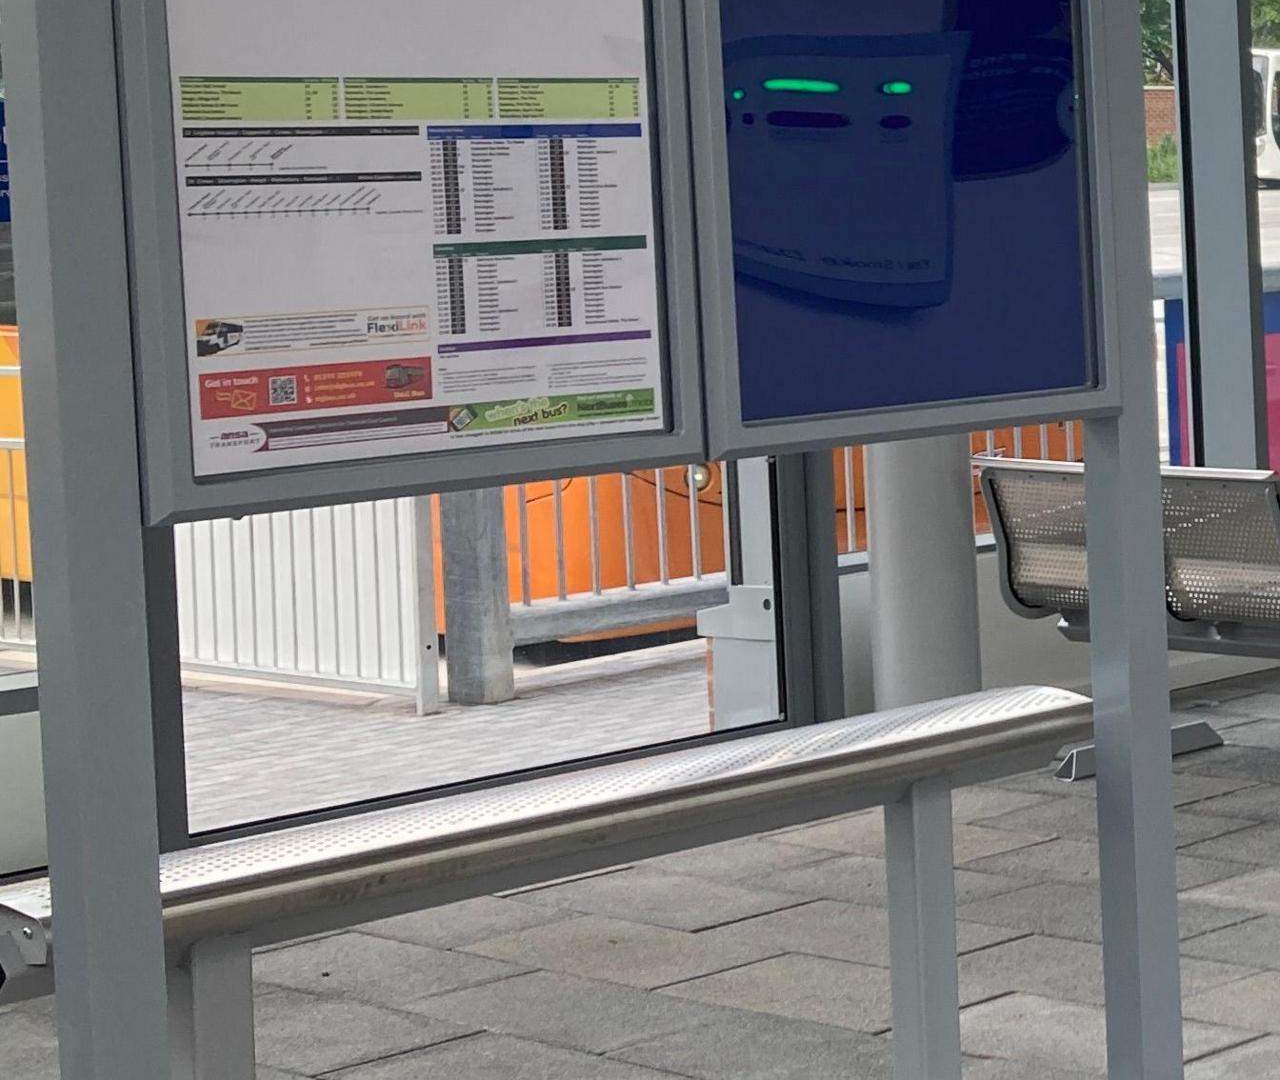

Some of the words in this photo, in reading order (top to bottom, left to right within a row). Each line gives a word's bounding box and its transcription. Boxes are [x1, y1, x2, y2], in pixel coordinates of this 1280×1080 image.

[367, 320, 428, 334] FlexiLink
[204, 377, 220, 388] Get
[221, 377, 232, 387] in
[233, 375, 258, 387] touch
[513, 410, 539, 427] next
[541, 403, 568, 420] bus?
